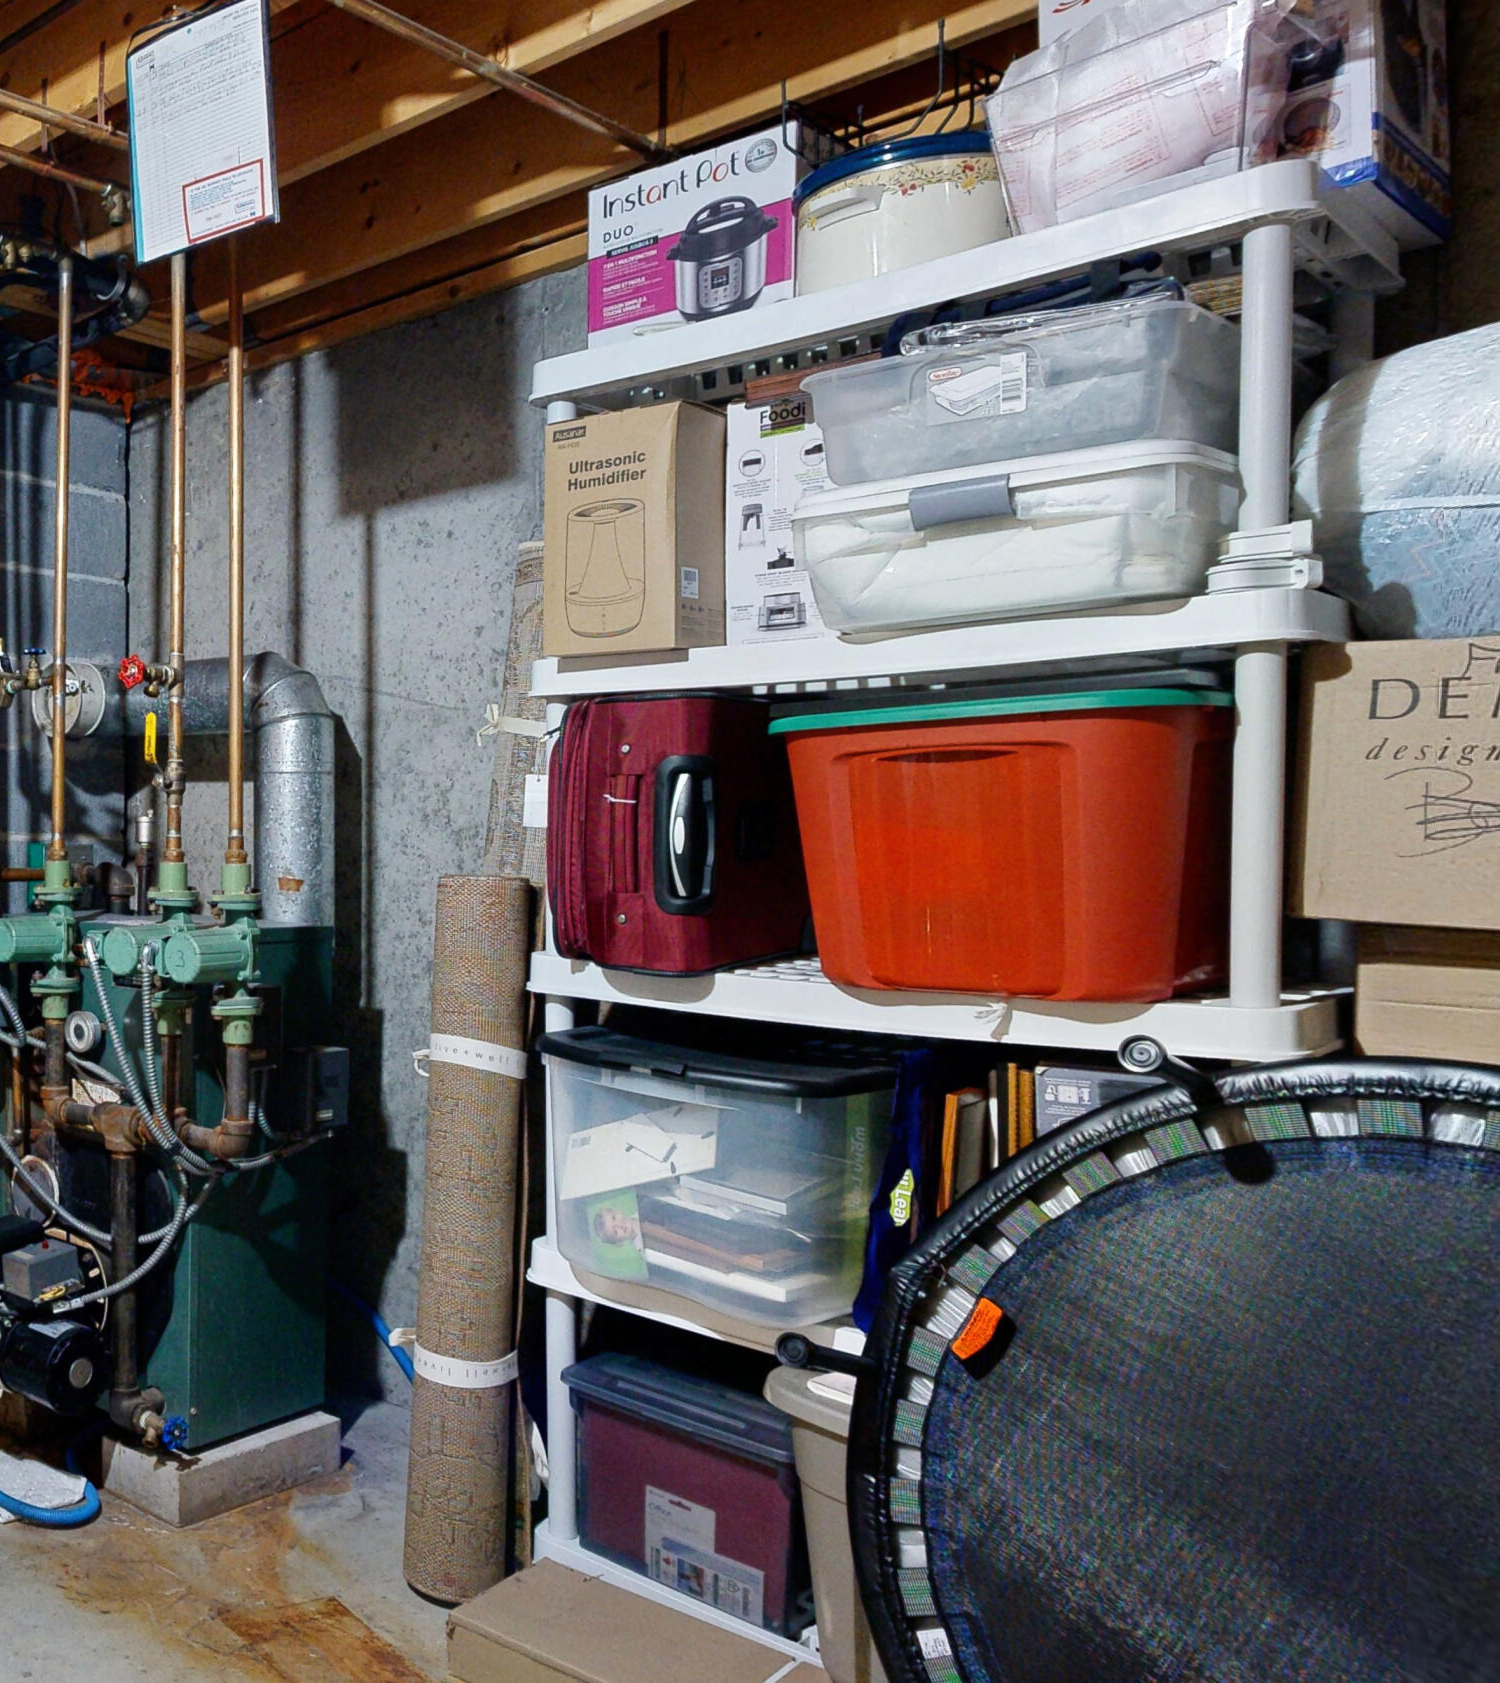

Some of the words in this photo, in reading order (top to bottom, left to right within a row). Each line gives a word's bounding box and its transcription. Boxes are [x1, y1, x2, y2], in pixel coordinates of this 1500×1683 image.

[603, 170, 688, 218] Instant
[697, 152, 739, 188] Pot
[603, 225, 634, 243] DUO
[760, 402, 805, 424] Foodi
[569, 451, 646, 474] Ultrasonic
[568, 468, 647, 491] Humidifier
